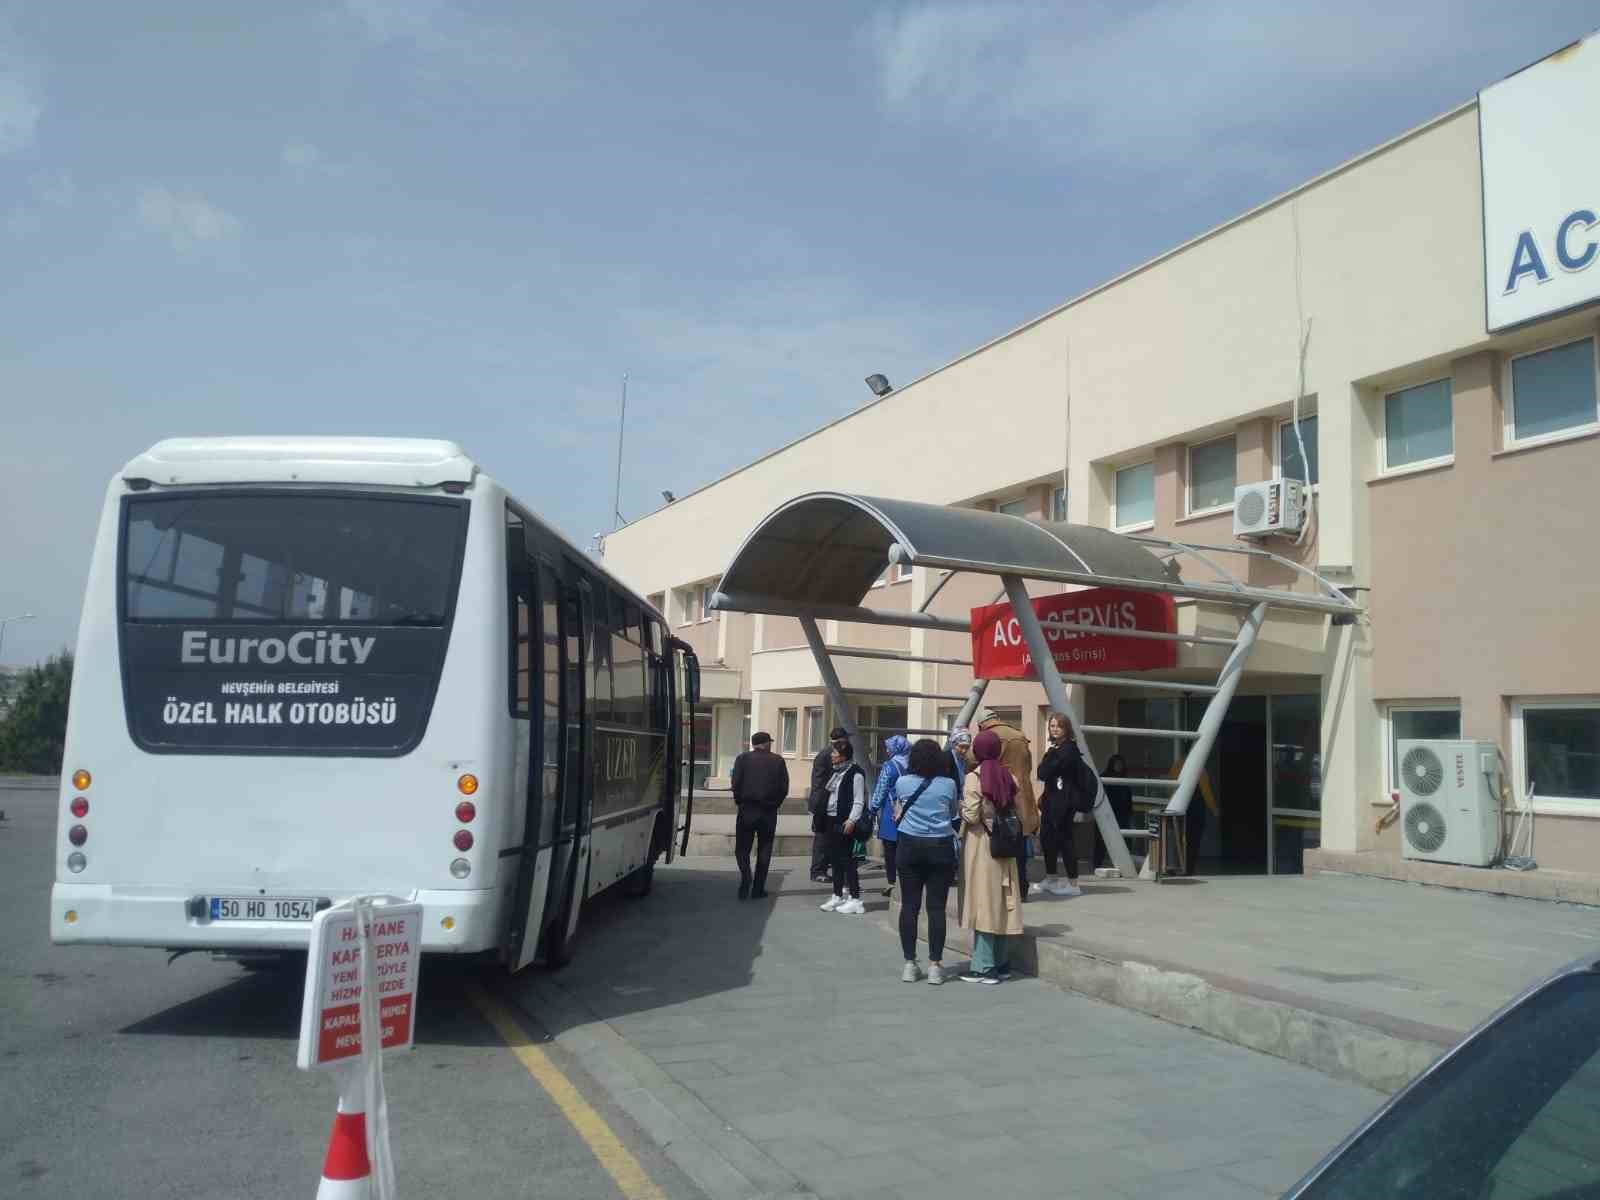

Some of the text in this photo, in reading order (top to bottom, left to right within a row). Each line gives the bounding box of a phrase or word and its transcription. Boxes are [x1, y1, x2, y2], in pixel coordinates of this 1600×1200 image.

[993, 617, 1029, 647] AC
[181, 630, 376, 665] EuroCity
[221, 680, 339, 696] NEVŞEHİR BELEDİYESİ
[163, 697, 397, 725] ÖZEL HALK OTOBÜSÜ
[221, 900, 239, 917] 50
[275, 902, 310, 919] 1054
[332, 942, 409, 966] KAFERYA
